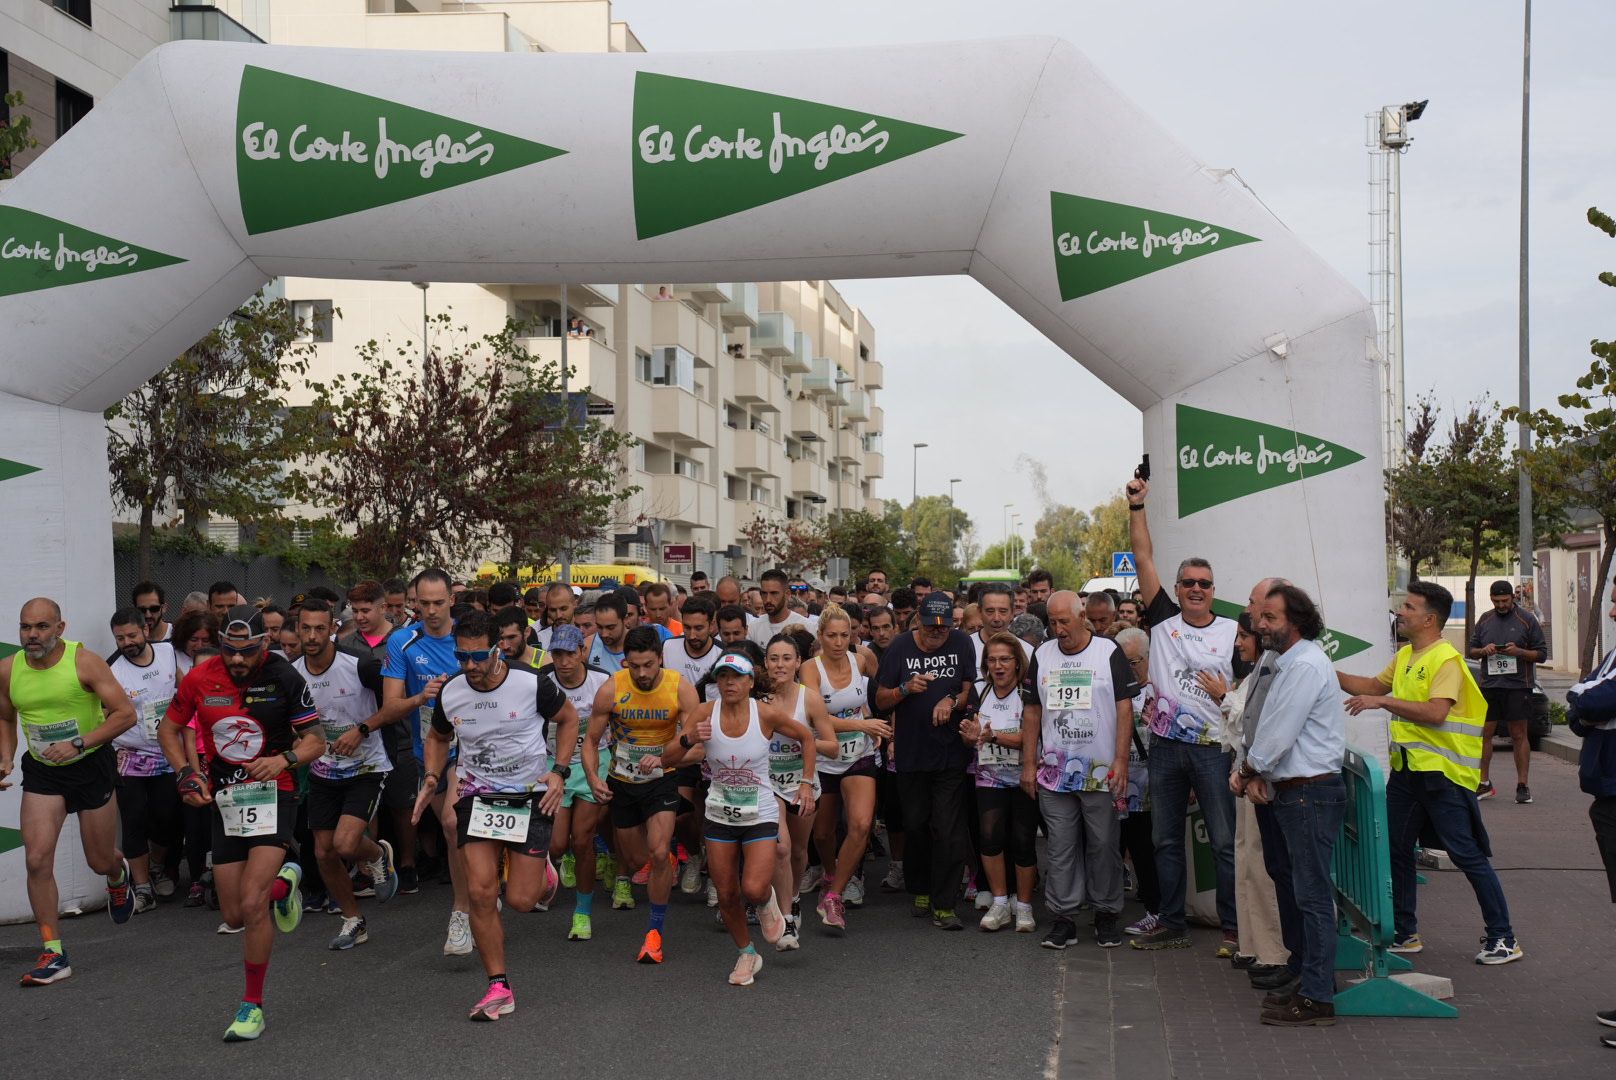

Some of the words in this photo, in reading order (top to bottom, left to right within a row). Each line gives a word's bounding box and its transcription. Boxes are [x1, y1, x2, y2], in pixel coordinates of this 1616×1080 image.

[243, 122, 281, 160] El
[289, 125, 368, 163] Corte
[375, 117, 494, 179] Inglés
[639, 125, 676, 164] El
[684, 125, 763, 163] Corte
[769, 112, 890, 174] Inglés
[1057, 232, 1082, 256] El
[1087, 230, 1139, 254] Corte
[1143, 220, 1220, 258] Inglés
[1, 237, 52, 260] Corte
[55, 233, 139, 272] Inglés
[1180, 445, 1199, 470] El
[1203, 444, 1253, 468] Corte
[1257, 434, 1333, 475] Inglés
[572, 575, 588, 583] UVI
[906, 658, 921, 669] VA
[924, 655, 947, 669] POR
[948, 654, 958, 665] TI
[1496, 660, 1508, 669] 96
[1057, 687, 1080, 700] 191
[621, 708, 670, 721] UKRAINE
[1061, 728, 1094, 739] Peñas
[841, 740, 857, 754] 17
[239, 807, 258, 824] 15
[723, 805, 742, 819] 55
[483, 812, 517, 831] 330
